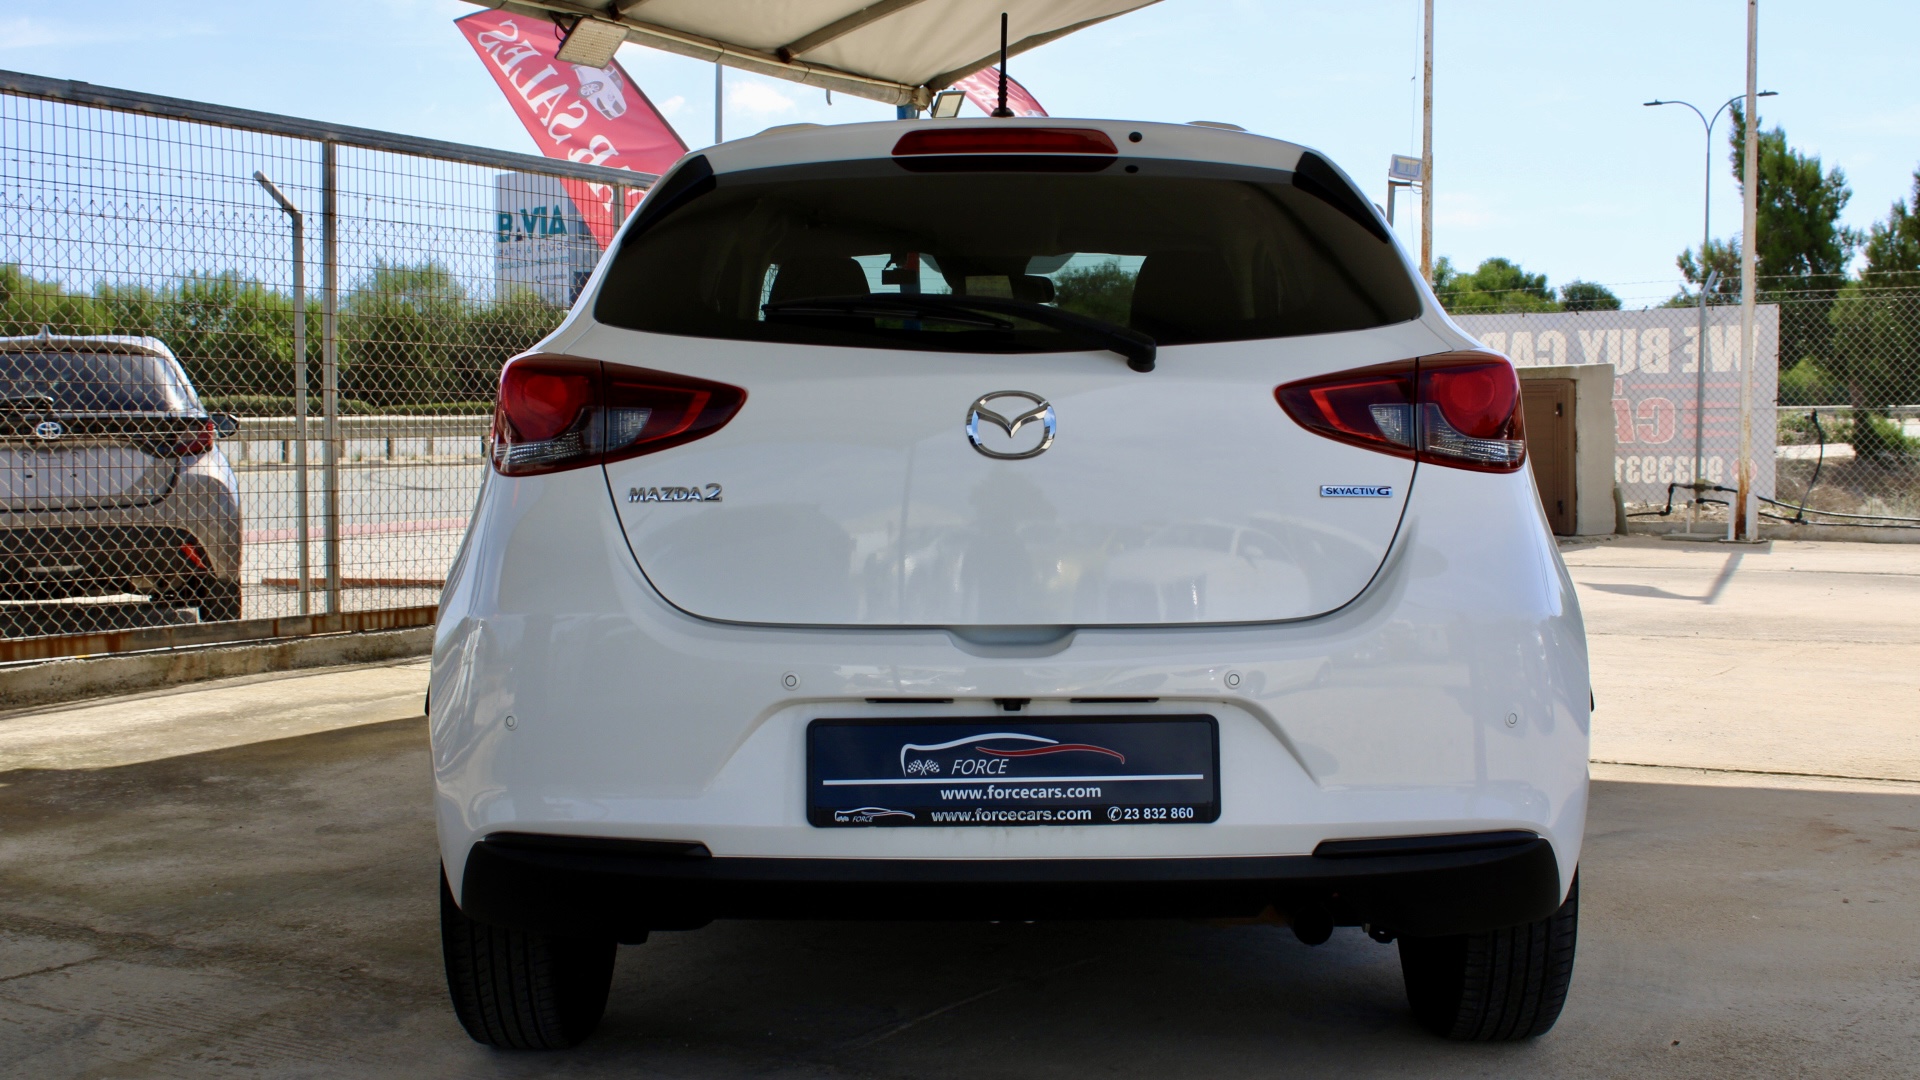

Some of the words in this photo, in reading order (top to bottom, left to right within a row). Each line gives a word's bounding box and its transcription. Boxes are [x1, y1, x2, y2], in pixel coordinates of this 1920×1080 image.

[951, 758, 1010, 775] FORCE
[940, 785, 1102, 800] www.forcecars.com
[852, 815, 874, 823] FORCE
[931, 808, 1092, 822] www.forcecars.com
[1124, 808, 1140, 820] 23
[1143, 807, 1167, 819] 832
[1170, 807, 1194, 819] 860
